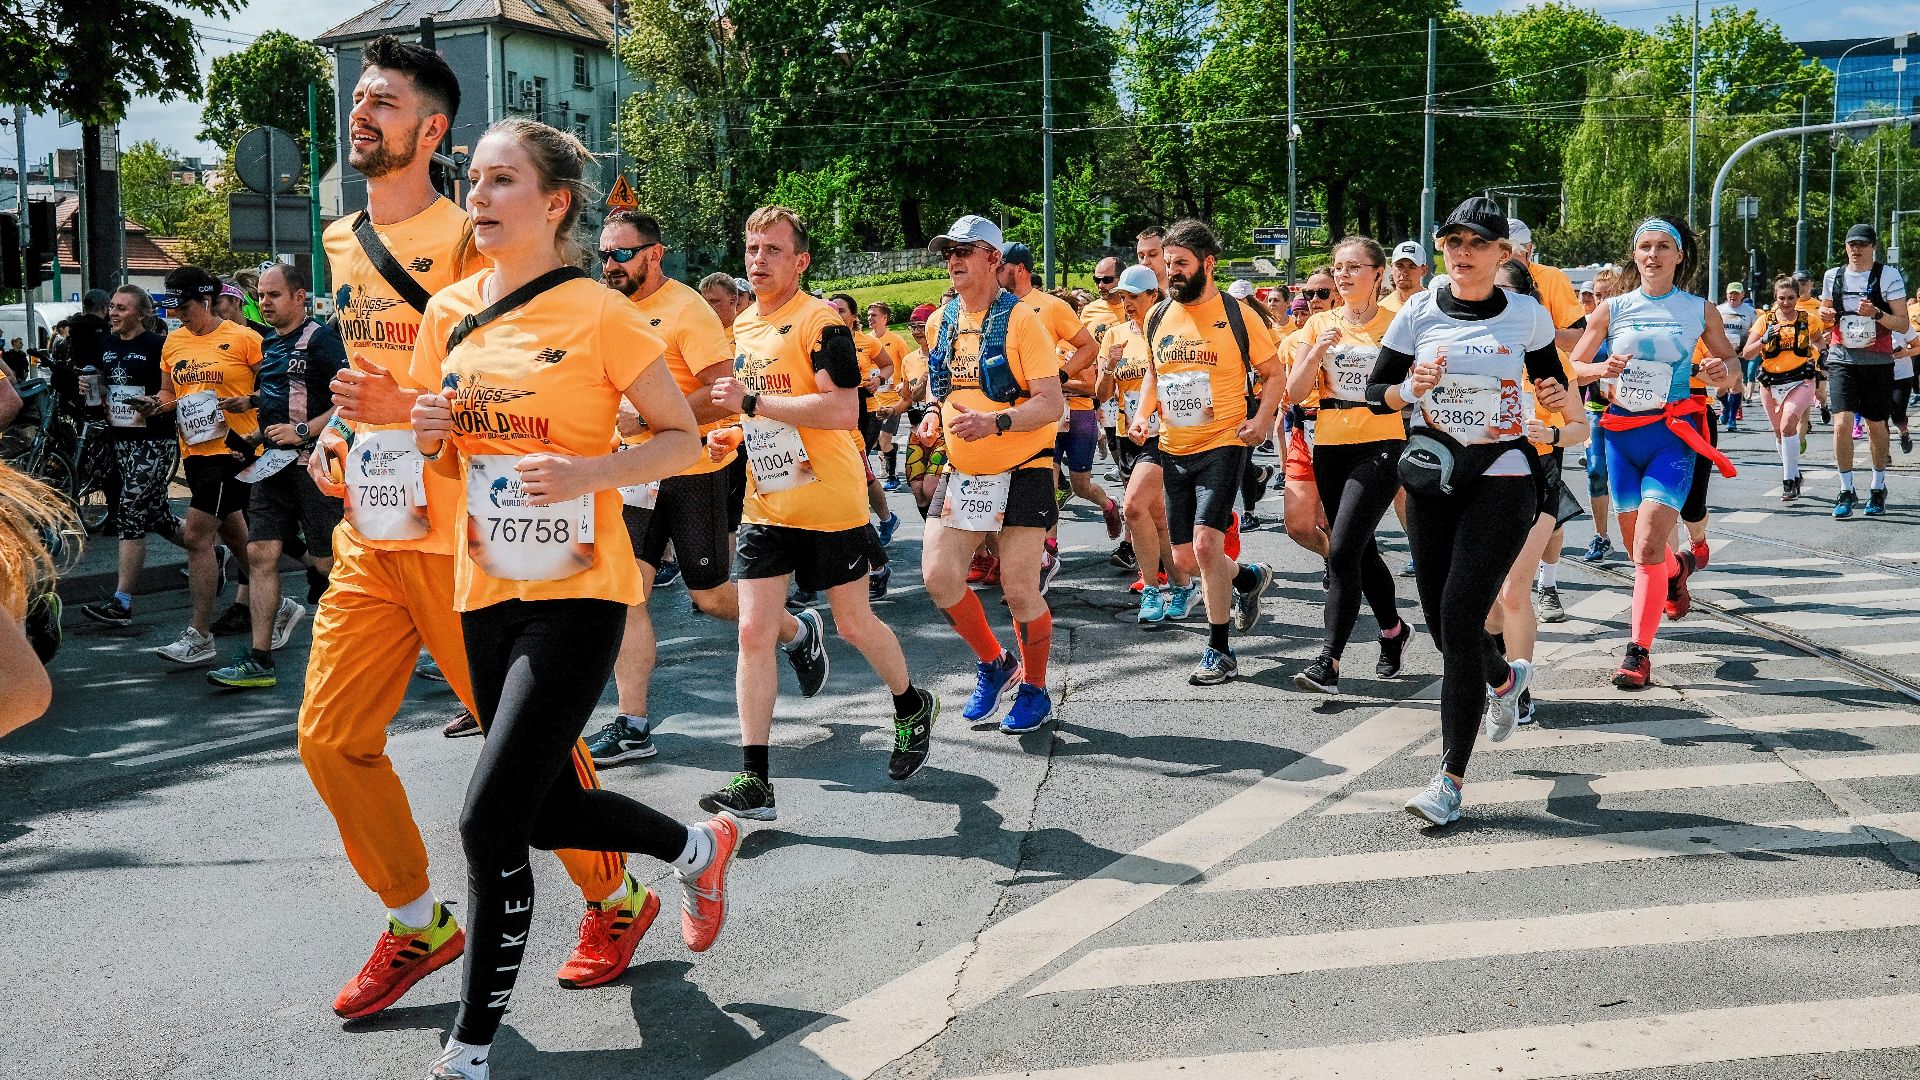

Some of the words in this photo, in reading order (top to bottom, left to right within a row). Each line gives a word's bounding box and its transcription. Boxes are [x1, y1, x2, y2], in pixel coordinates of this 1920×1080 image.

[1465, 345, 1494, 355] ING
[455, 389, 503, 401] WINGS
[1620, 386, 1654, 401] 9796
[1167, 397, 1202, 411] 19266
[1430, 409, 1486, 426] 23862
[1491, 412, 1499, 424] 4
[751, 450, 794, 471] 11004
[799, 448, 806, 458] 4
[358, 485, 408, 507] 79631
[961, 499, 993, 513] 7596
[487, 517, 570, 543] 76758
[487, 896, 531, 1008] NIKE
